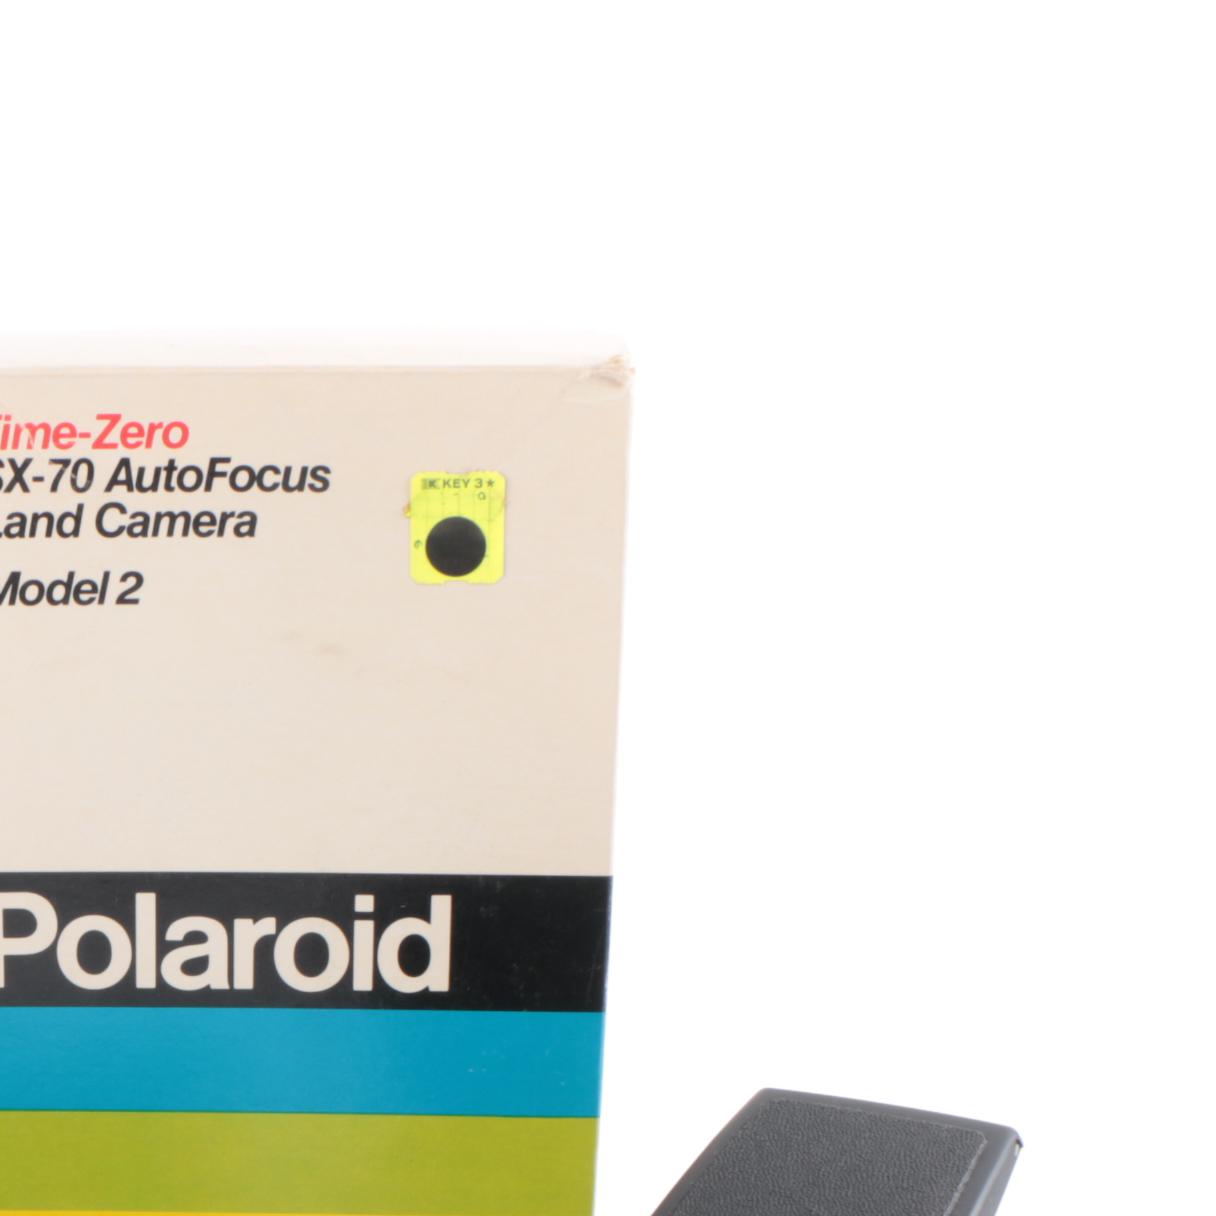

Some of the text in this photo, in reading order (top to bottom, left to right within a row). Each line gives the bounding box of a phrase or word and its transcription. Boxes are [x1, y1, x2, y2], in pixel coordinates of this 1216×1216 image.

[104, 456, 331, 494] AutoFocus
[442, 479, 470, 489] KEY
[95, 502, 258, 539] Camera
[115, 570, 144, 605] 2
